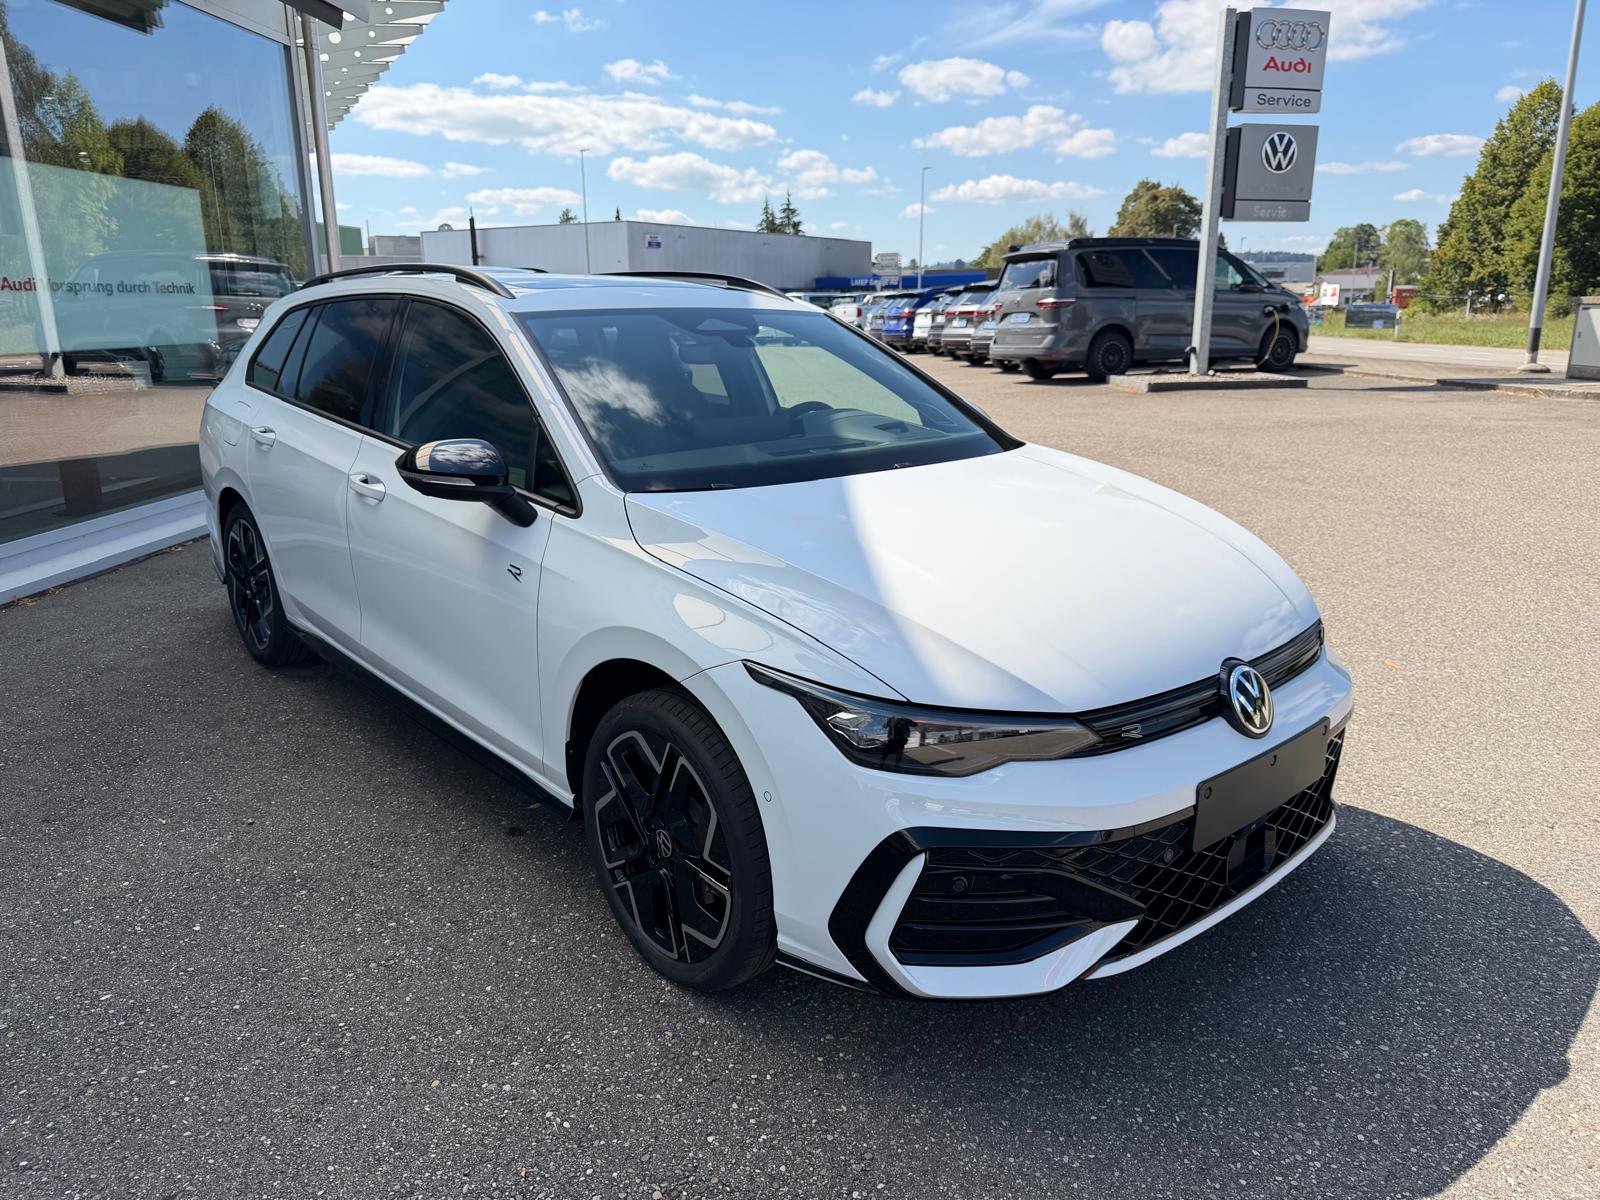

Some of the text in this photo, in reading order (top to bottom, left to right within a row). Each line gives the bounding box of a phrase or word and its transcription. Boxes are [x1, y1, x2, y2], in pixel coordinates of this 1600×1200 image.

[1263, 56, 1312, 73] Audi
[1256, 93, 1312, 108] Service
[1, 277, 195, 296] Audi orsprung durch Technik
